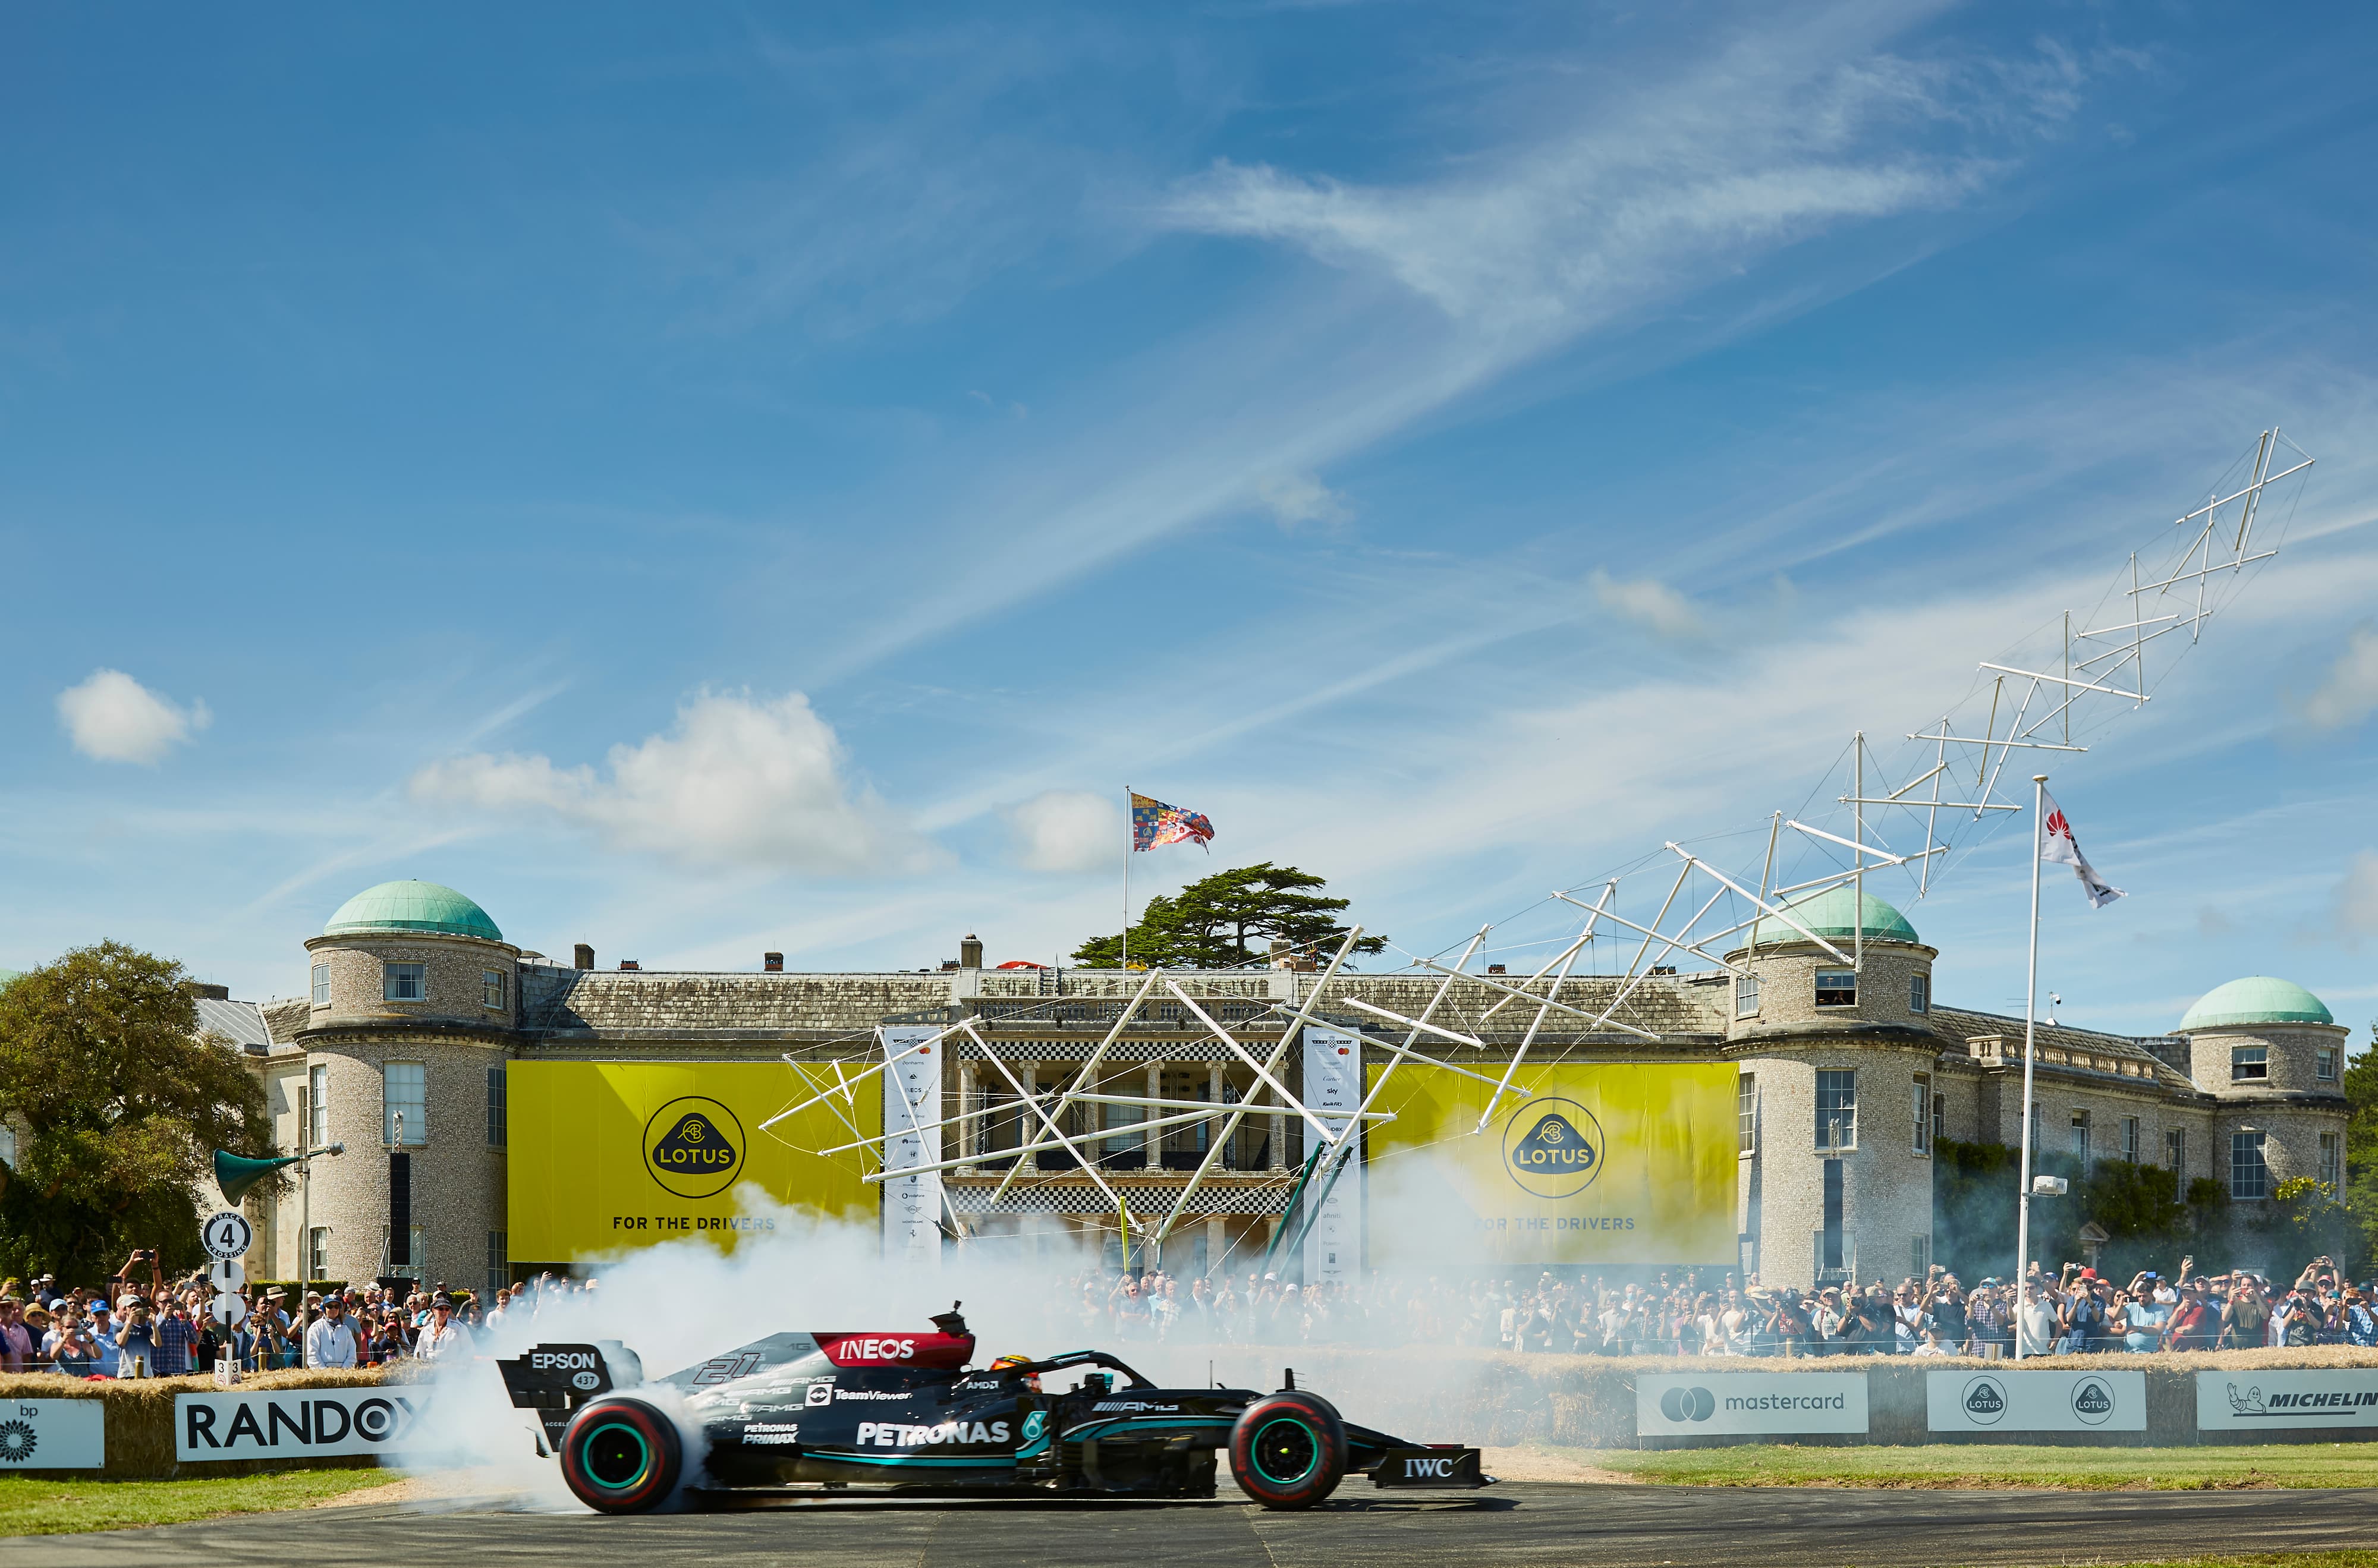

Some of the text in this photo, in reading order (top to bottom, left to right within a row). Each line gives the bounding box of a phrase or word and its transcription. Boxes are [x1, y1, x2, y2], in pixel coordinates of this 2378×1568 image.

[660, 1148, 731, 1164] LOTUS
[1520, 1148, 1589, 1164] LOTUS
[213, 1213, 241, 1223] TRACK
[614, 1217, 775, 1230] FOR THE DRIVERS
[1474, 1217, 1634, 1230] FOR THE DRIVERS
[220, 1224, 235, 1248] 4
[208, 1245, 247, 1258] CROSSING
[838, 1339, 915, 1359] INEOS
[218, 1362, 224, 1373] 3
[232, 1362, 238, 1373] 3
[531, 1353, 595, 1369] EPSON
[693, 1352, 761, 1384] 21
[577, 1376, 595, 1385] 437
[966, 1381, 990, 1390] AMD
[833, 1389, 913, 1400] TeamViewer
[1726, 1392, 1844, 1410] mastercard
[2269, 1392, 2378, 1408] MICHELIN
[758, 1403, 804, 1413] AMG
[1969, 1400, 2002, 1409] LOTUS
[2078, 1400, 2109, 1409] LOTUS
[20, 1405, 38, 1419] bp
[186, 1397, 432, 1449] RANDOX
[744, 1422, 798, 1432] PETRONAS
[742, 1432, 800, 1444] PRIMAX
[856, 1421, 1011, 1447] PETRONAS
[1404, 1459, 1454, 1478] IWC
